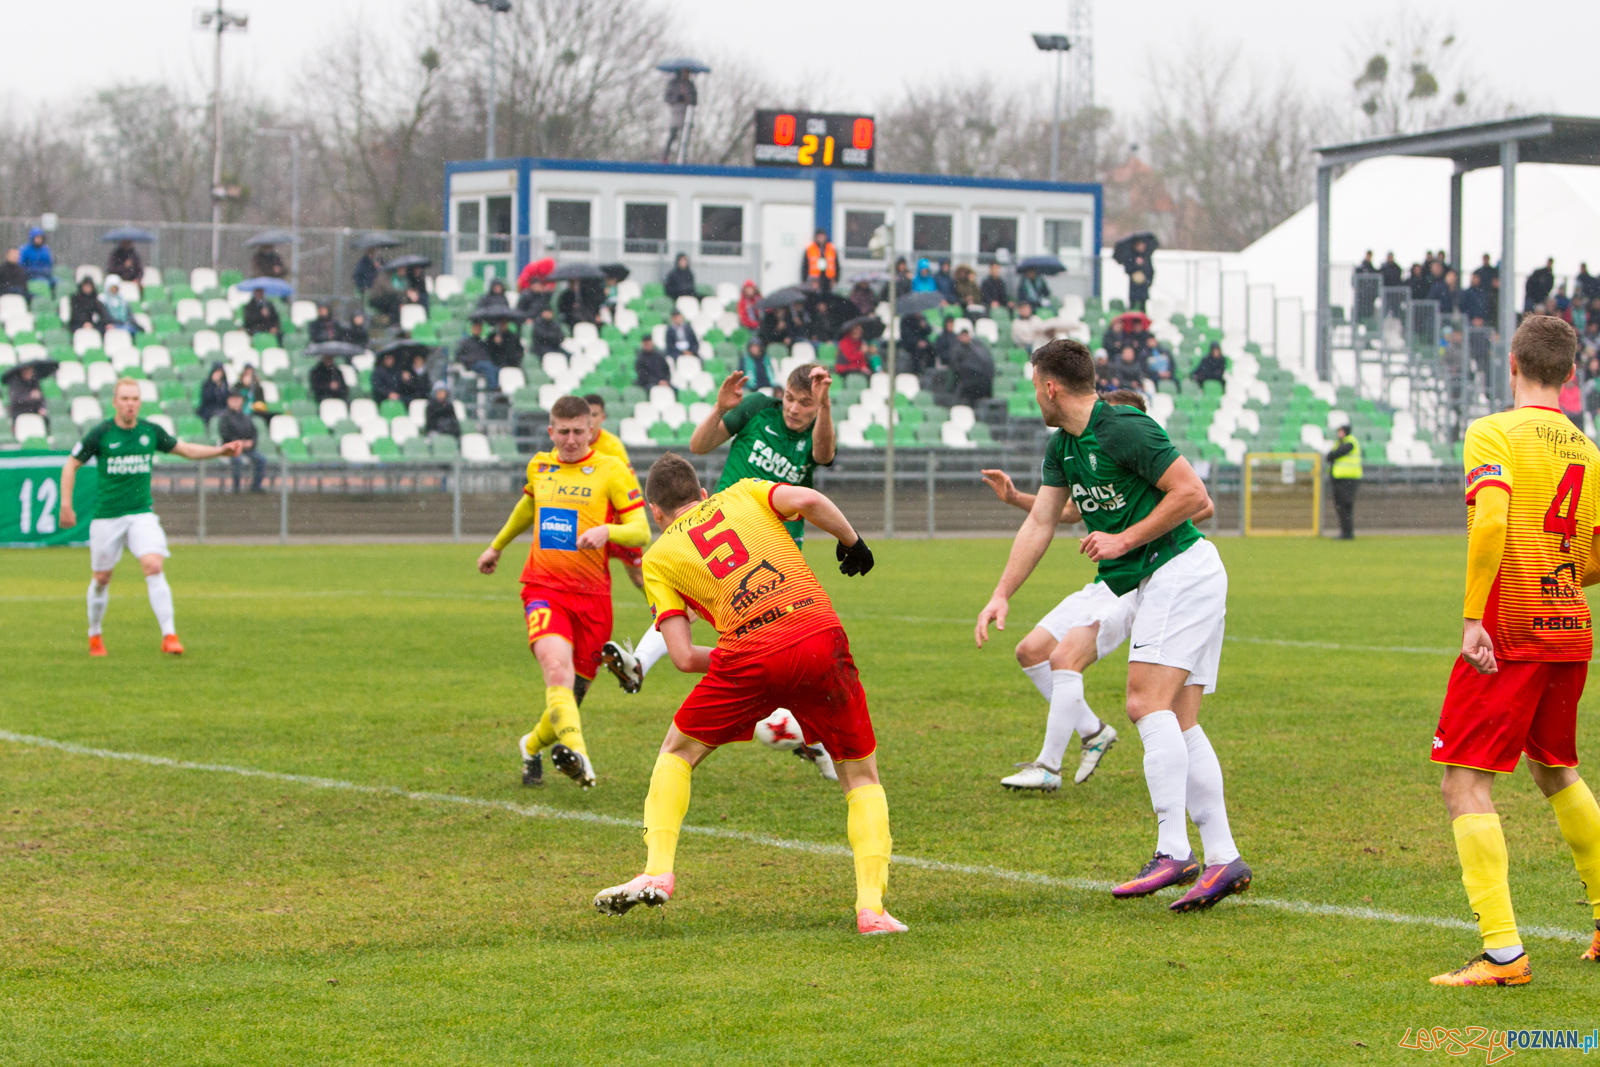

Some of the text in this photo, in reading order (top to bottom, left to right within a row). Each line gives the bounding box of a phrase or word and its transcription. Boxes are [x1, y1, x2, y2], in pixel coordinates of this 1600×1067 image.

[774, 114, 796, 146] 0
[853, 118, 873, 150] 0
[798, 134, 835, 166] 21
[107, 463, 151, 475] HOUSE
[1559, 450, 1590, 462] DESIGN
[19, 477, 58, 534] 12
[557, 486, 592, 498] KZB
[1544, 463, 1586, 553] 4
[541, 522, 573, 533] STABEK
[688, 508, 749, 580] 5
[528, 607, 552, 636] 27
